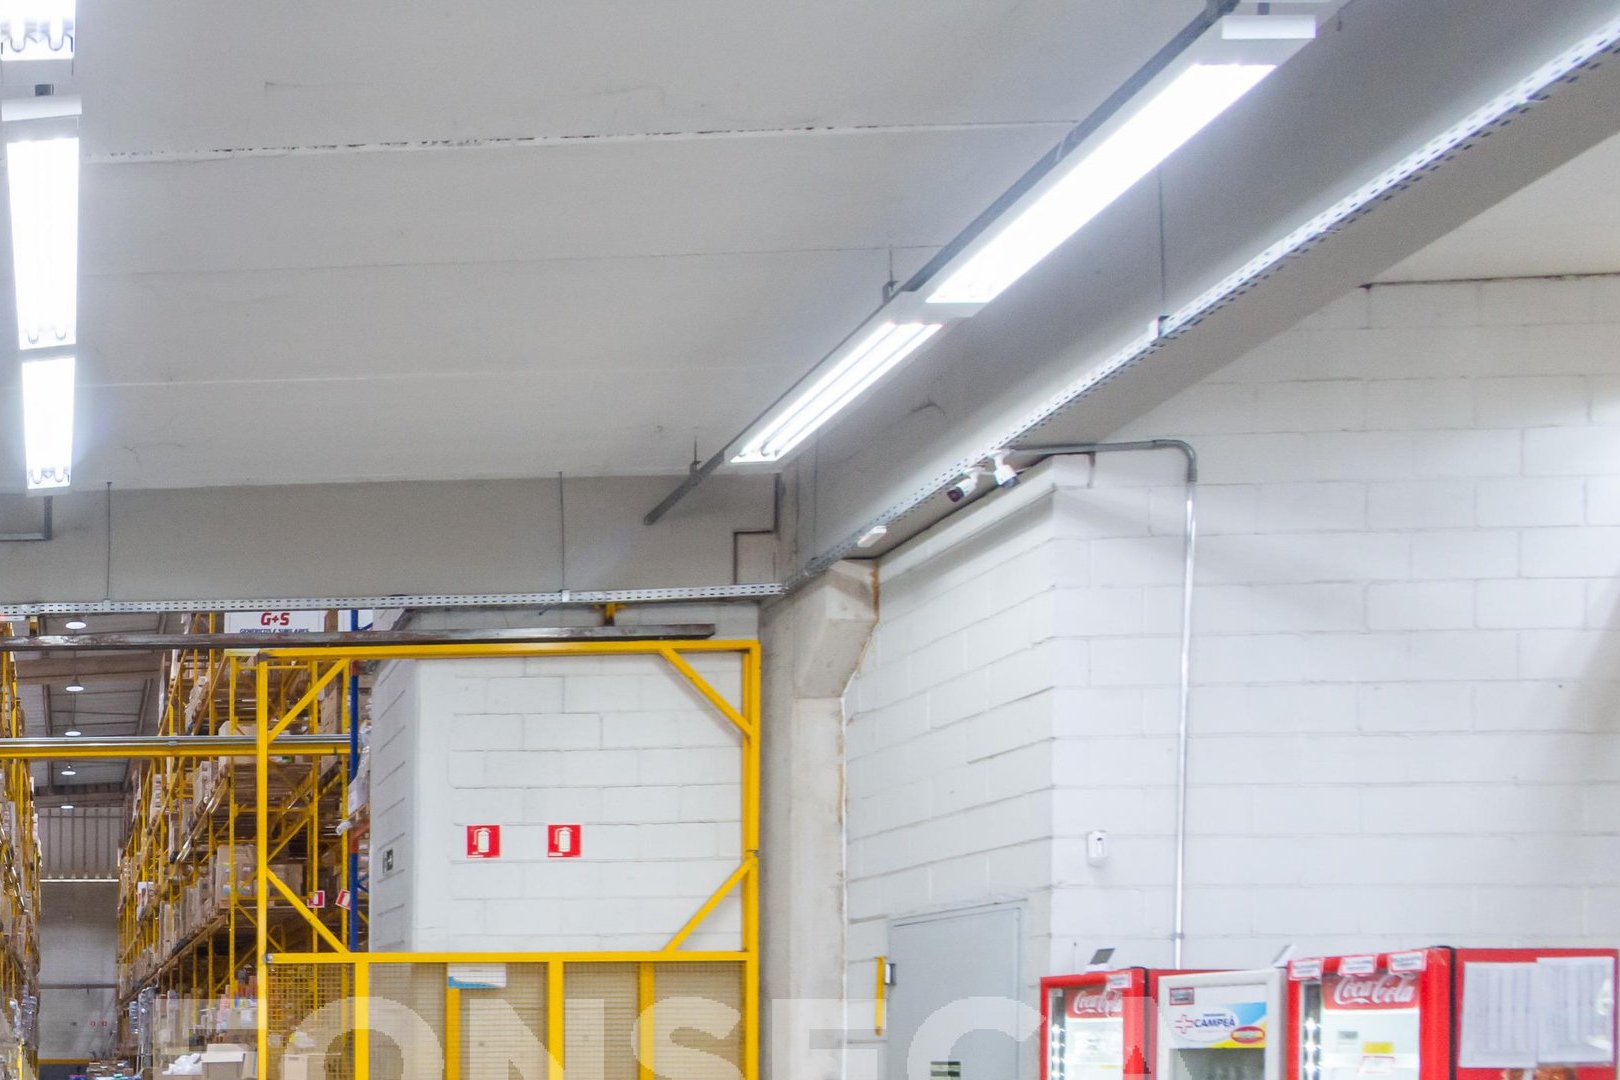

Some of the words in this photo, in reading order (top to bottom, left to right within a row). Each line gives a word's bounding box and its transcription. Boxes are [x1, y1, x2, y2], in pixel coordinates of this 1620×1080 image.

[260, 612, 290, 625] G+S
[1334, 974, 1416, 1005] Coca-Cola
[1194, 1016, 1236, 1028] CAMPEÃ
